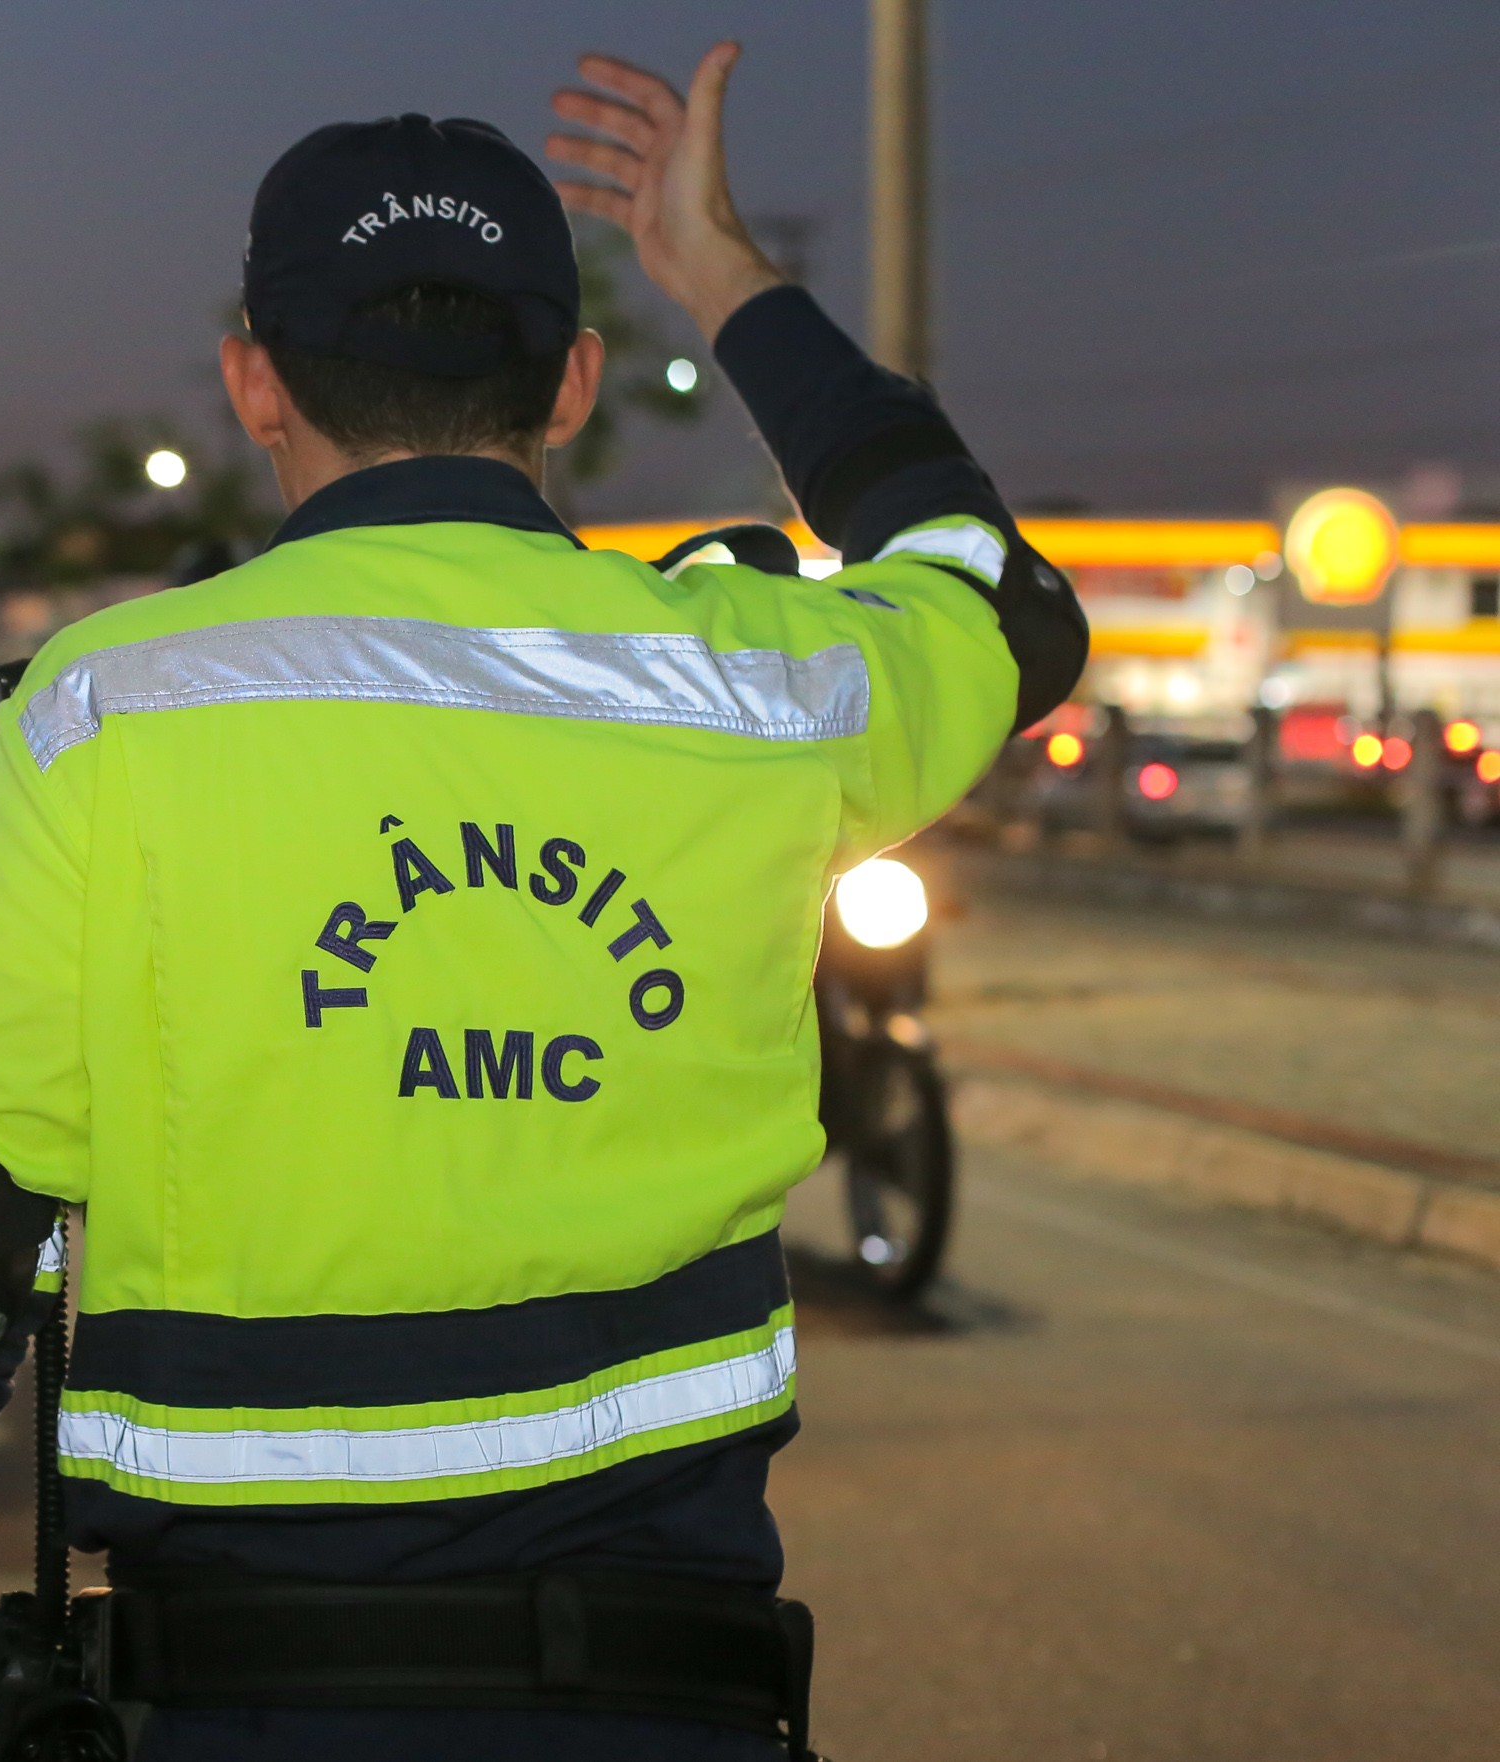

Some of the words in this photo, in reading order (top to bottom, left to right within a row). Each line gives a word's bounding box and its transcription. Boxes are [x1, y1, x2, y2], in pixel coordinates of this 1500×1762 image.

[342, 192, 503, 244] TRÂNSITO
[301, 814, 685, 1030] TRÂNSITO
[397, 1027, 605, 1103] AMC
